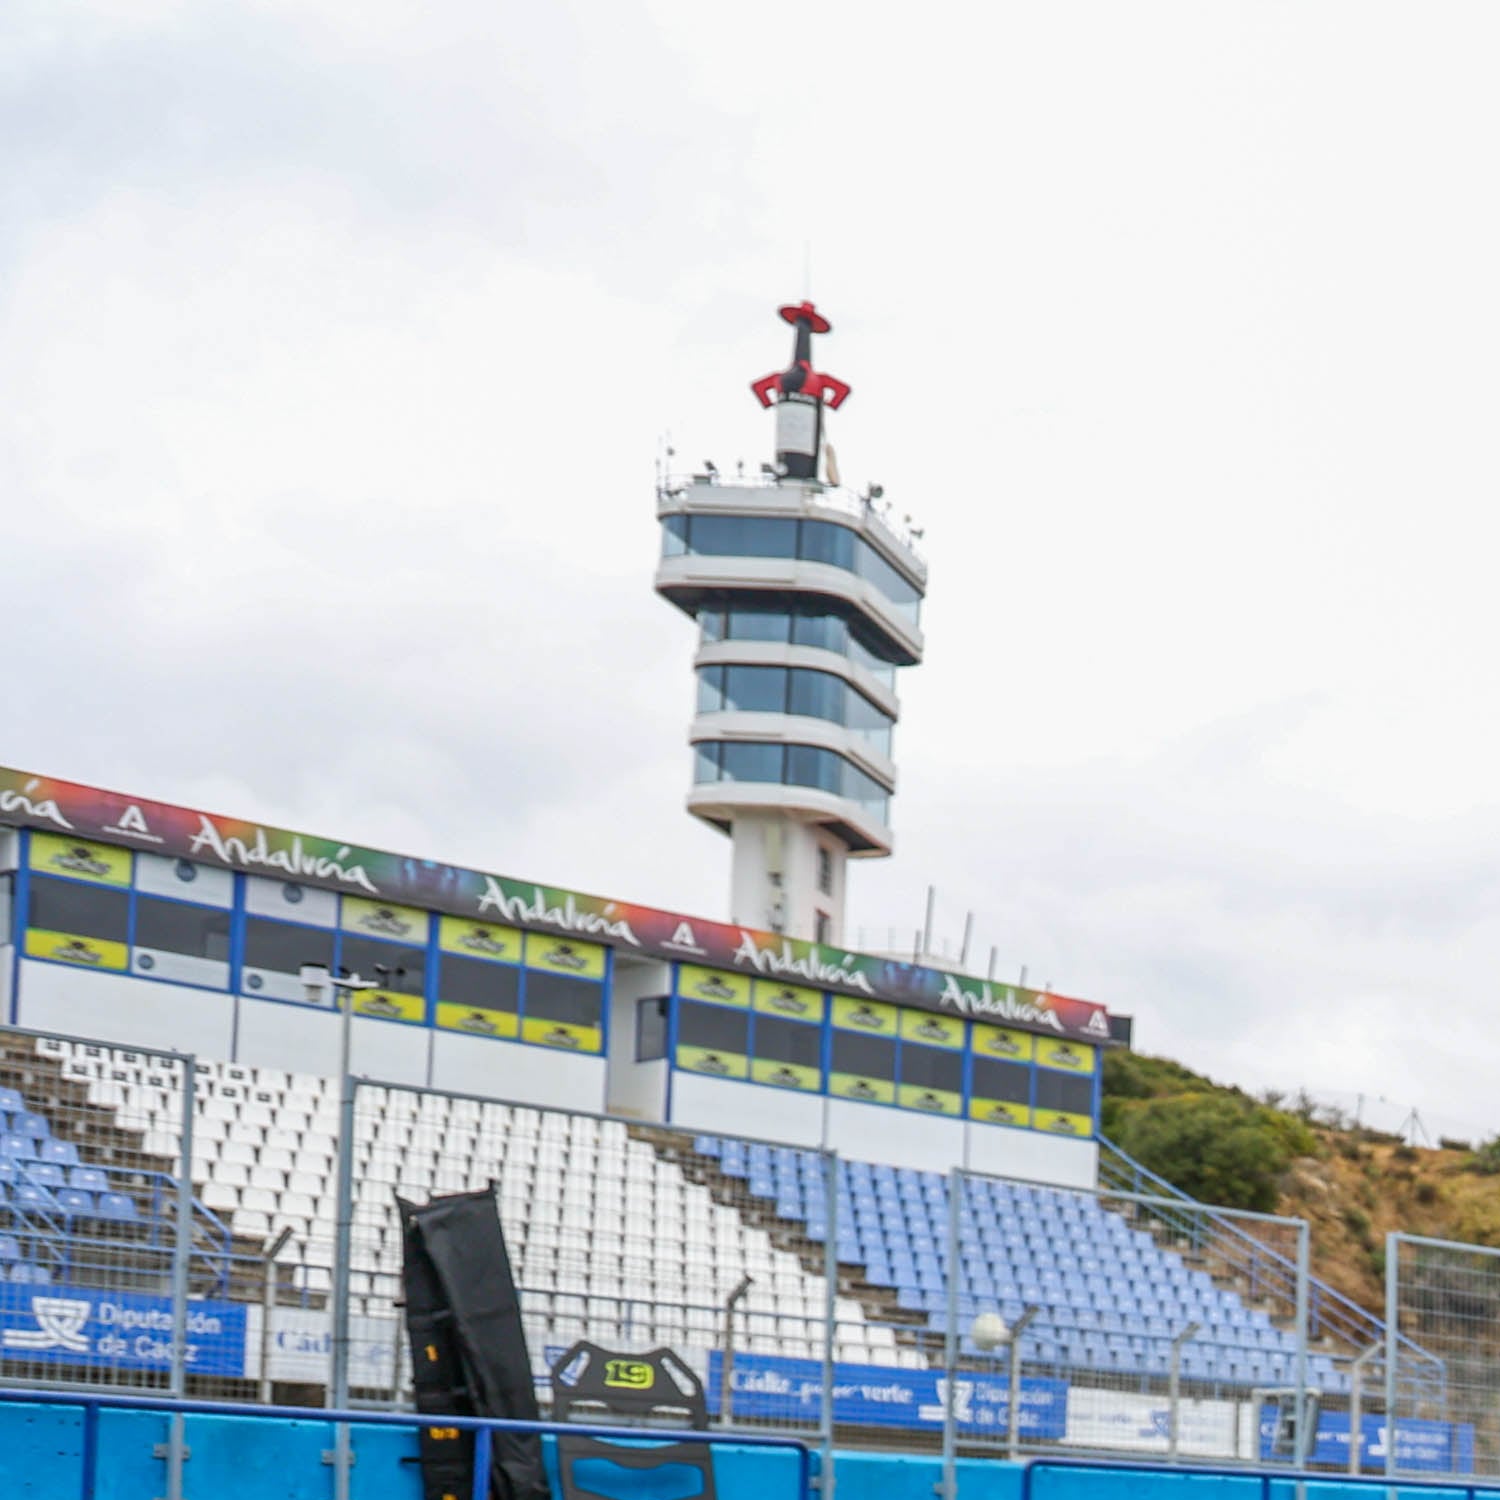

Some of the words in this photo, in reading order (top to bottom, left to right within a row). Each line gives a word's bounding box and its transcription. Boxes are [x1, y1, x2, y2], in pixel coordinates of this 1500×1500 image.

[188, 813, 379, 893] Andalucía
[477, 876, 641, 947] Andalucía
[733, 930, 876, 994] Andalucía
[940, 974, 1065, 1031] Andalucía
